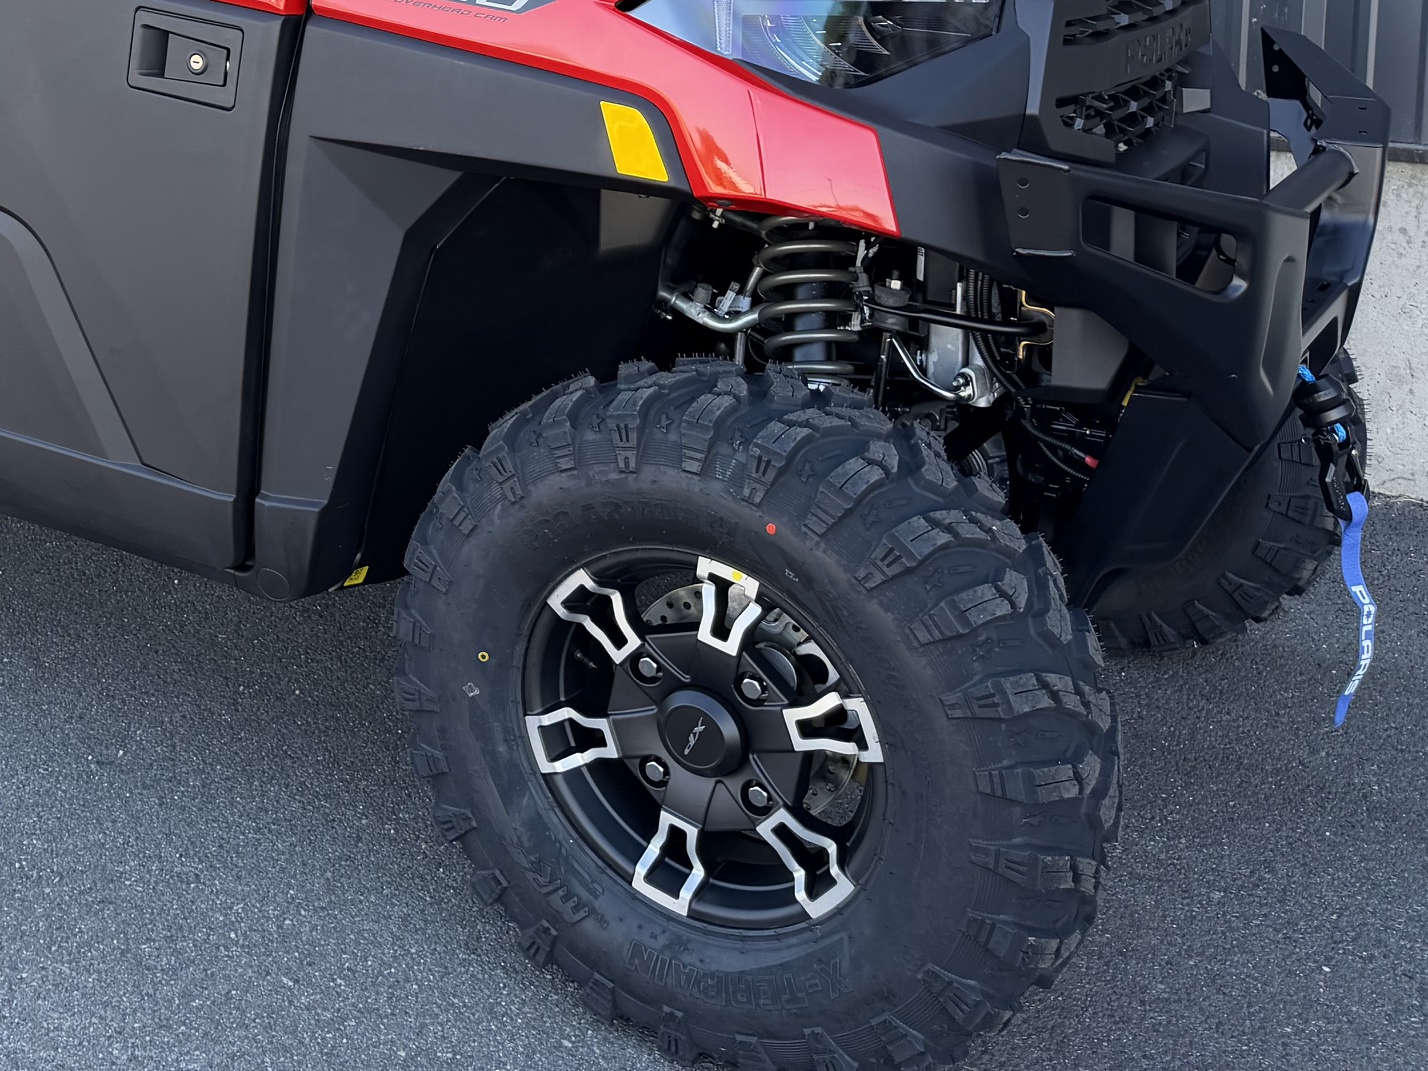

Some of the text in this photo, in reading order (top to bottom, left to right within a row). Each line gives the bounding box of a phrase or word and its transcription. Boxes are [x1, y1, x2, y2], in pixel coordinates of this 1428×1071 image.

[473, 11, 509, 23] CAM
[1343, 584, 1377, 697] POLARIS
[624, 938, 854, 1012] X-TERRAIN
